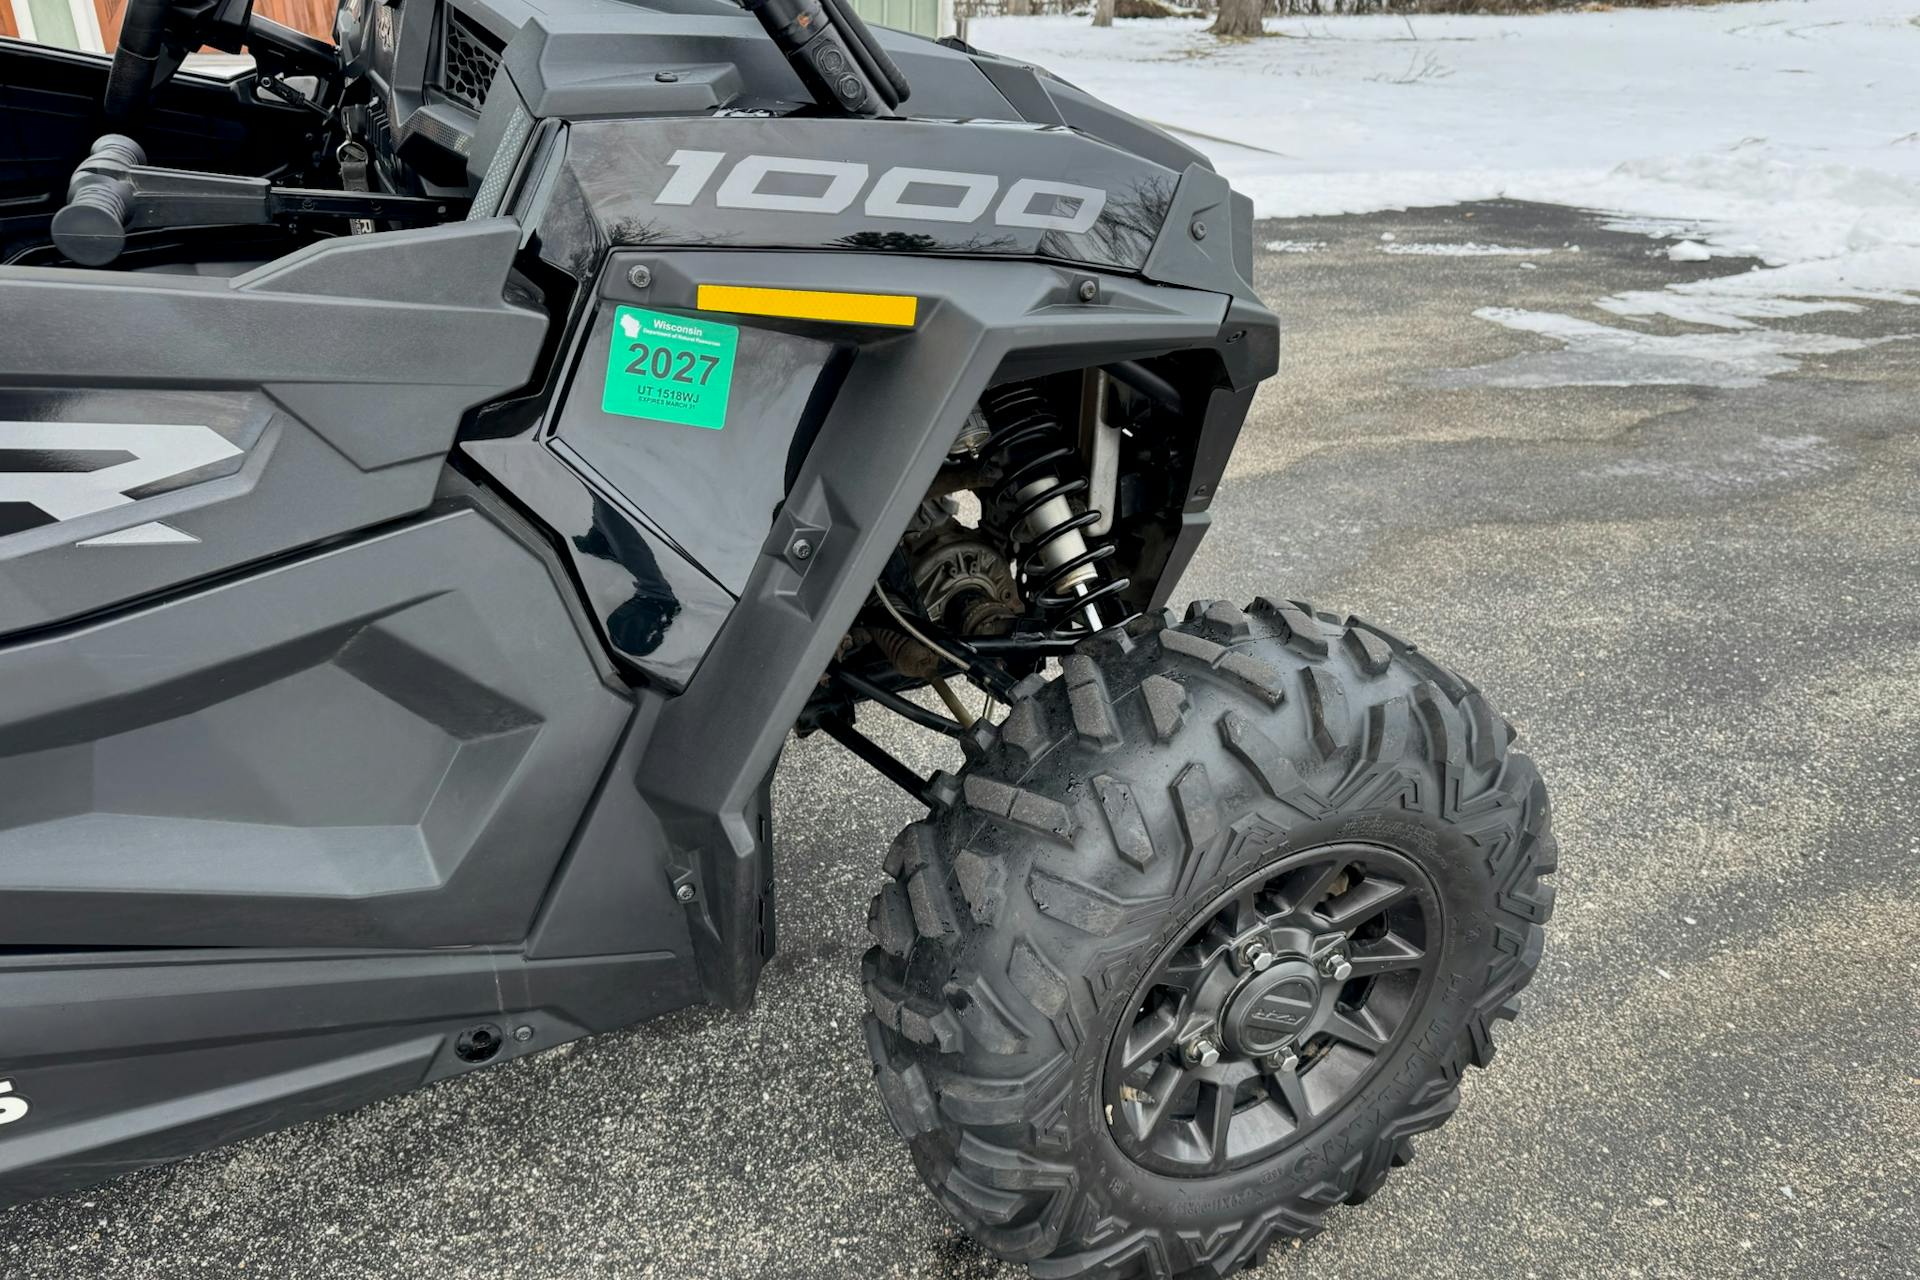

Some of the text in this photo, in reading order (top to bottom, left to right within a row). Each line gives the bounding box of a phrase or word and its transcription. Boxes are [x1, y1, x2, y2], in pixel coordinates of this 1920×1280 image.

[652, 149, 1107, 233] 1000
[653, 319, 703, 337] Wisconsin
[624, 342, 720, 387] 2027
[637, 384, 700, 404] UT 1518WJ
[665, 400, 688, 409] MARCH
